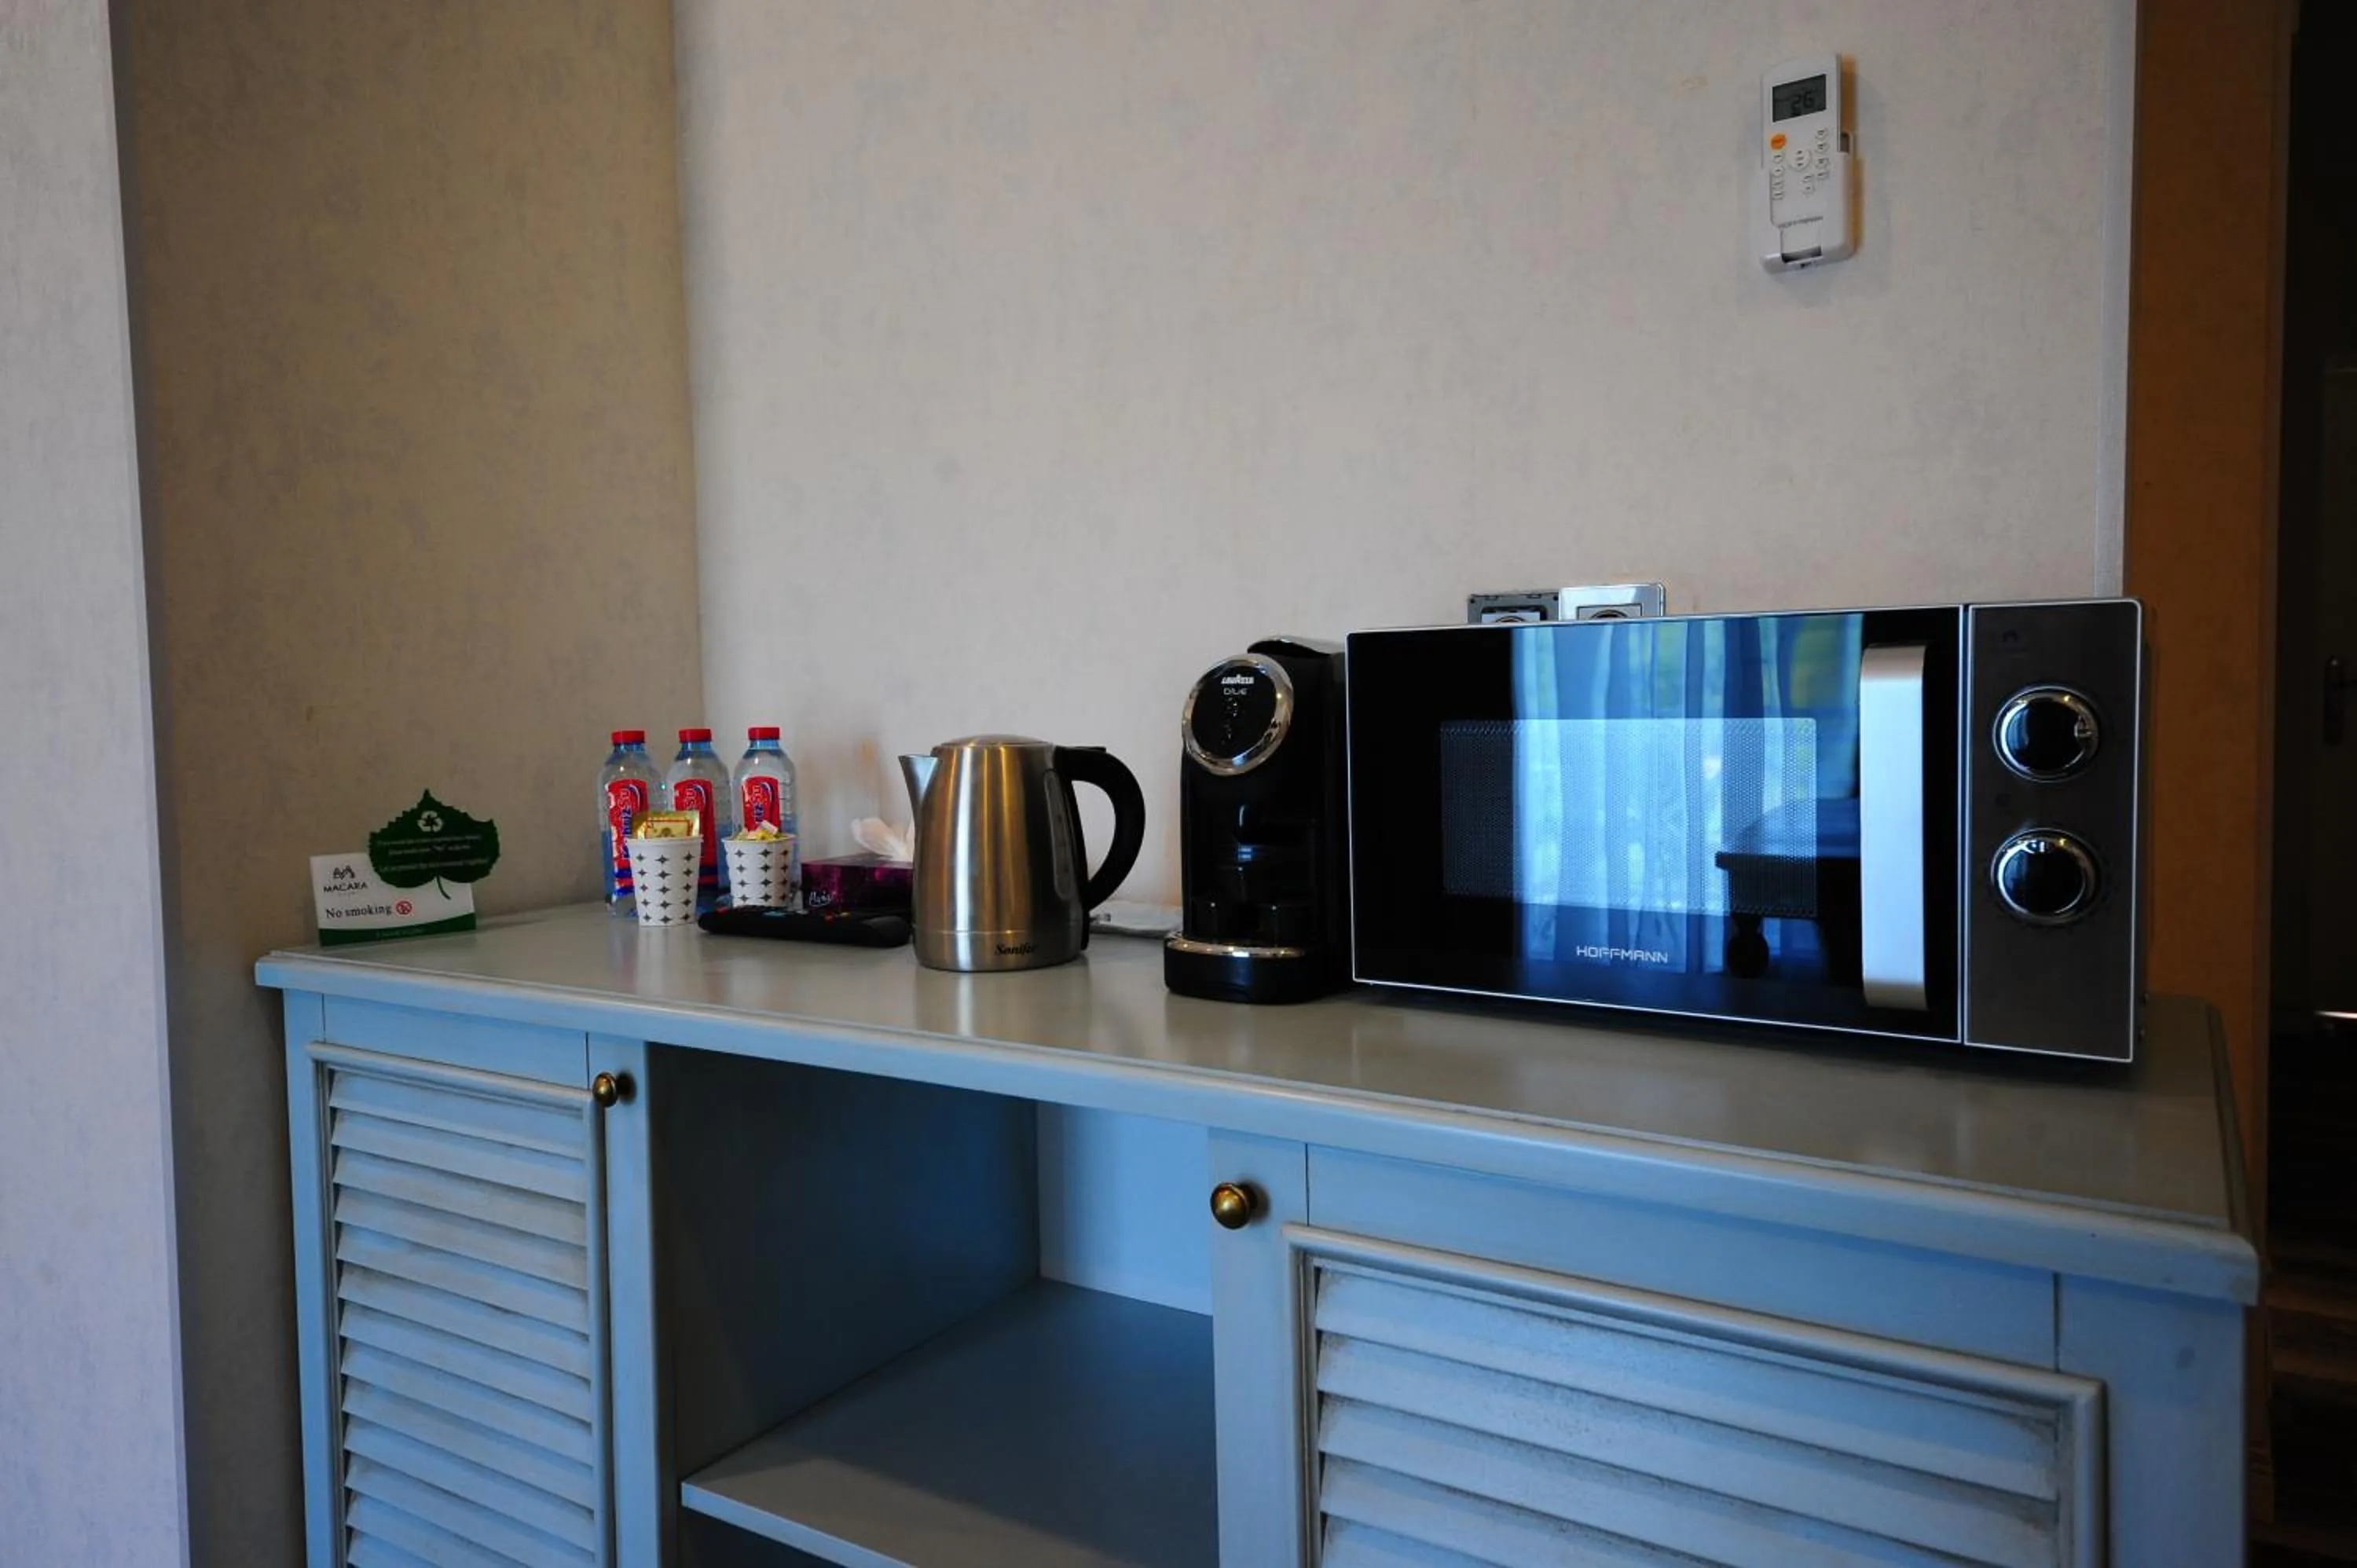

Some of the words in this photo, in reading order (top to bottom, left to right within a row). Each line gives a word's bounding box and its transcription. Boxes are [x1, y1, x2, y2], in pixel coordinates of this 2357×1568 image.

[1791, 91, 1814, 115] 26
[326, 907, 342, 918] No
[345, 904, 392, 917] smoking
[1576, 945, 1668, 964] HOFFMANN
